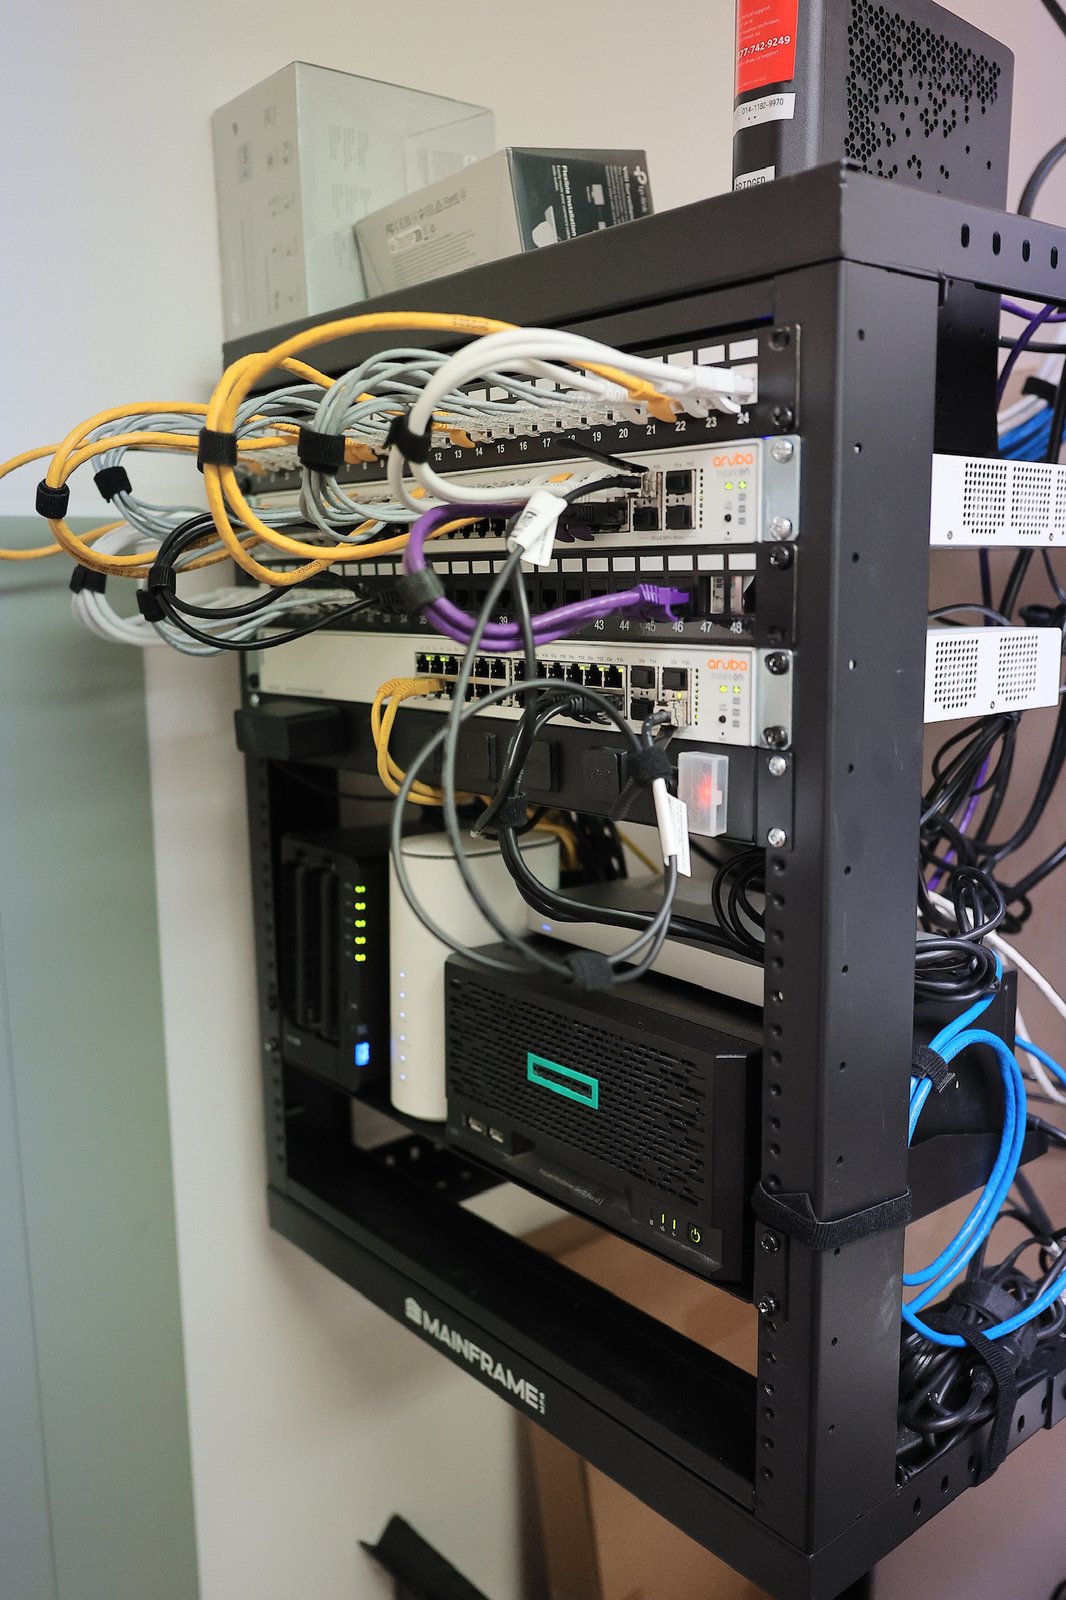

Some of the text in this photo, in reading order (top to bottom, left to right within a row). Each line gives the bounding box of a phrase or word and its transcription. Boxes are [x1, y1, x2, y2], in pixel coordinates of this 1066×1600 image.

[742, 98, 784, 115] 014-1182-9970
[562, 165, 577, 237] Flexible Installation
[705, 416, 717, 428] 23
[737, 412, 750, 425] 24
[646, 425, 656, 435] 21
[675, 420, 686, 432] 22
[592, 431, 602, 442] 19
[618, 428, 629, 438] 20
[496, 444, 505, 453] 15
[519, 441, 528, 451] 16
[542, 437, 551, 448] 17
[434, 453, 443, 461] 12
[454, 450, 462, 459] 13
[475, 447, 483, 456] 14
[712, 452, 754, 468] aruba
[499, 616, 508, 625] 39
[594, 619, 605, 631] 43
[619, 620, 630, 631] 44
[645, 620, 656, 632] 45
[672, 620, 684, 633] 46
[700, 621, 712, 633] 47
[729, 621, 743, 634] 48
[707, 657, 748, 671] aruba
[422, 1310, 539, 1410] MAINFRAME
